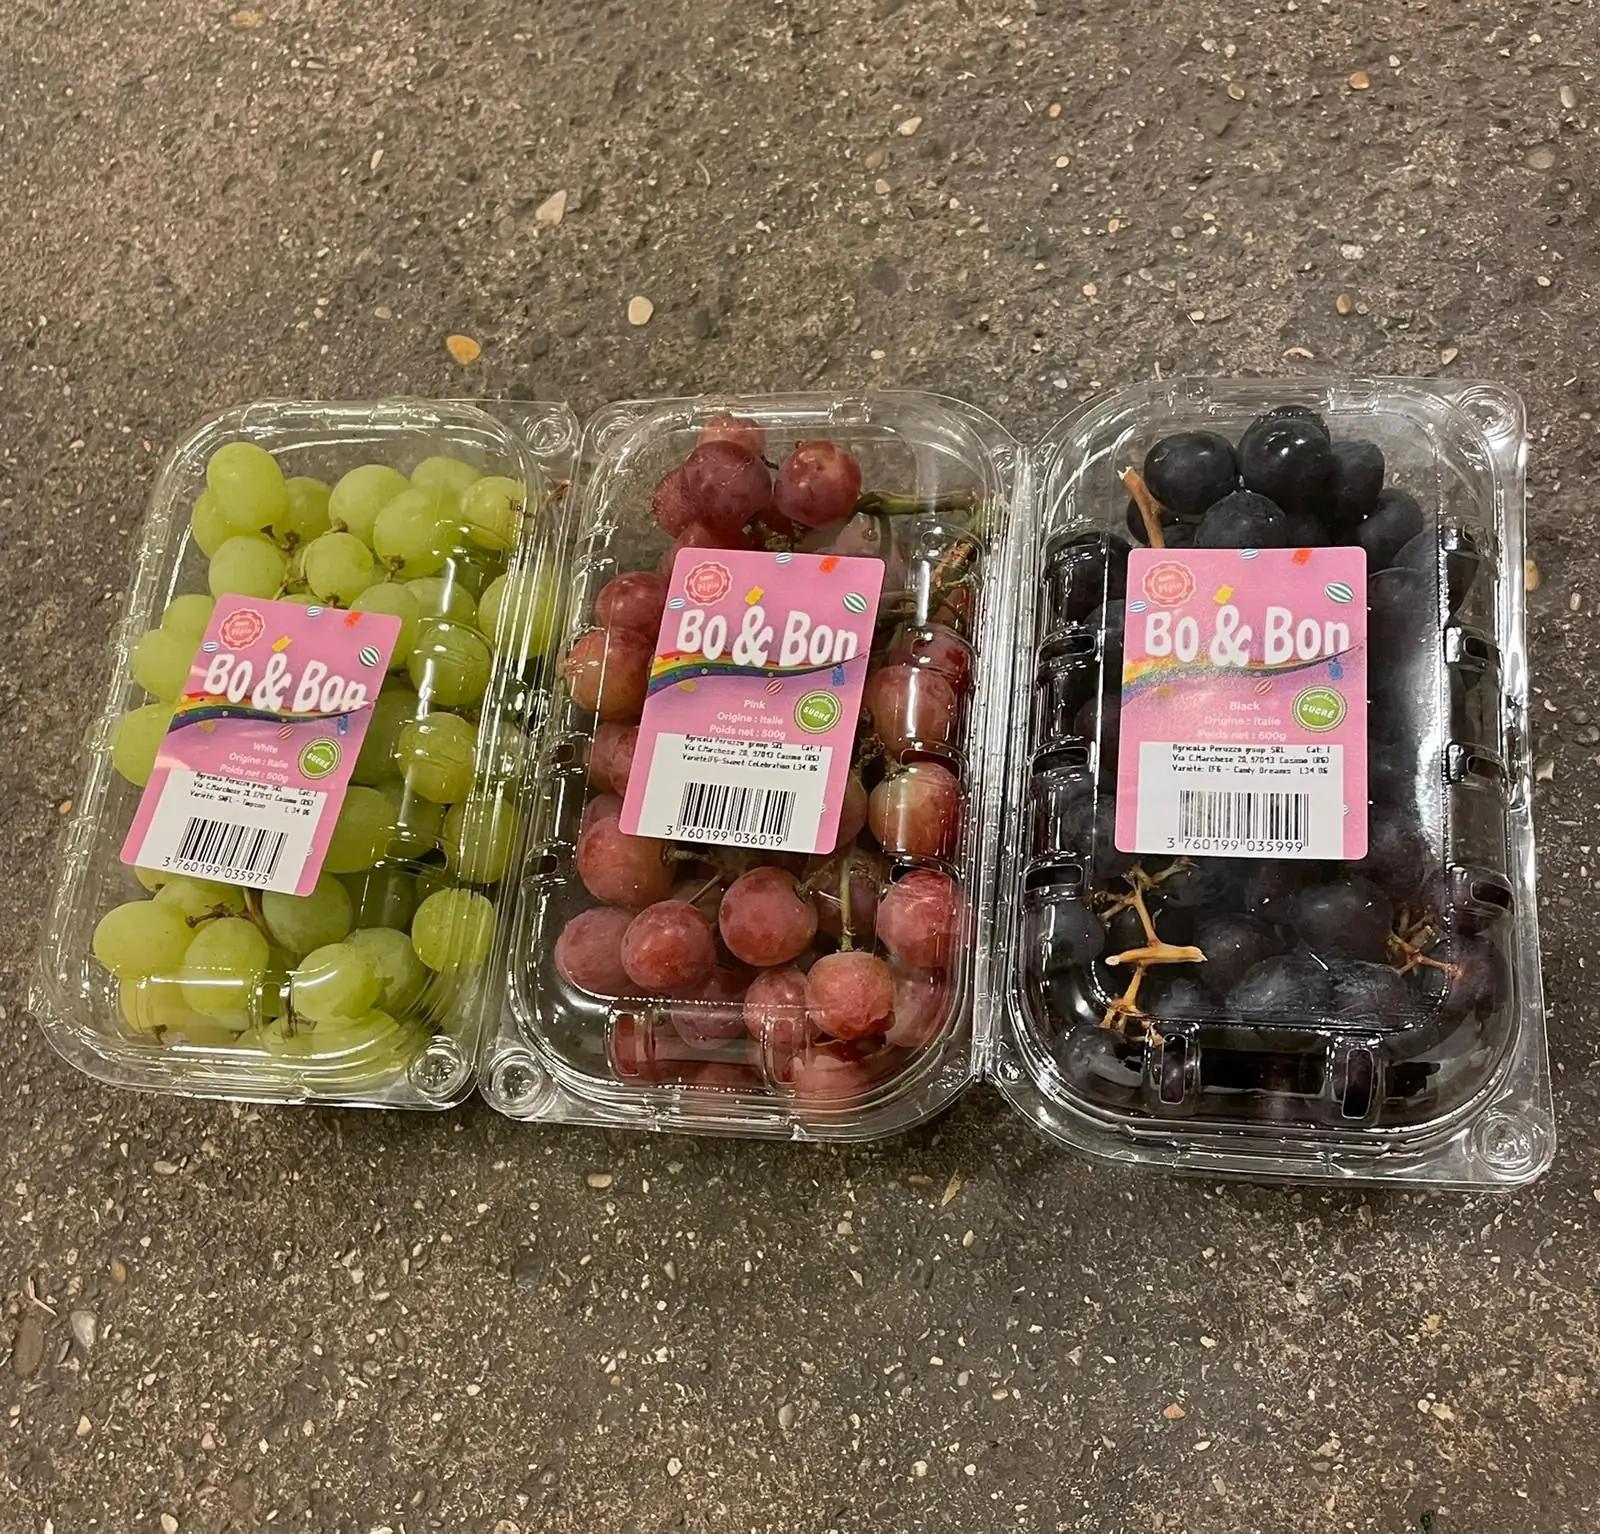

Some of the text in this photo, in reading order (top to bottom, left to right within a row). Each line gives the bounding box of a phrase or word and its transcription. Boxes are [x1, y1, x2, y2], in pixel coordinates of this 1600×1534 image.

[676, 605, 858, 667] Bo & Bon
[1145, 605, 1349, 667] Bo & Bon
[203, 653, 367, 713] Bo & Bon
[744, 700, 766, 710] Pink
[1229, 701, 1260, 711] Black
[717, 711, 752, 724] Origine
[760, 714, 783, 725] Italie
[1254, 716, 1281, 727] Italie
[709, 724, 736, 735] Poids
[738, 727, 754, 737] net
[762, 729, 786, 740] 500g
[1231, 731, 1248, 740] net
[1258, 731, 1287, 742] 500g
[253, 741, 278, 754] White
[229, 752, 260, 766] Origine
[219, 763, 244, 776] Poids
[245, 769, 260, 779] net
[266, 771, 289, 784] 500g
[664, 825, 783, 847] 3 760199 036019
[1166, 837, 1303, 853] 3 760199 035999
[162, 856, 269, 885] 3 760199 035975
